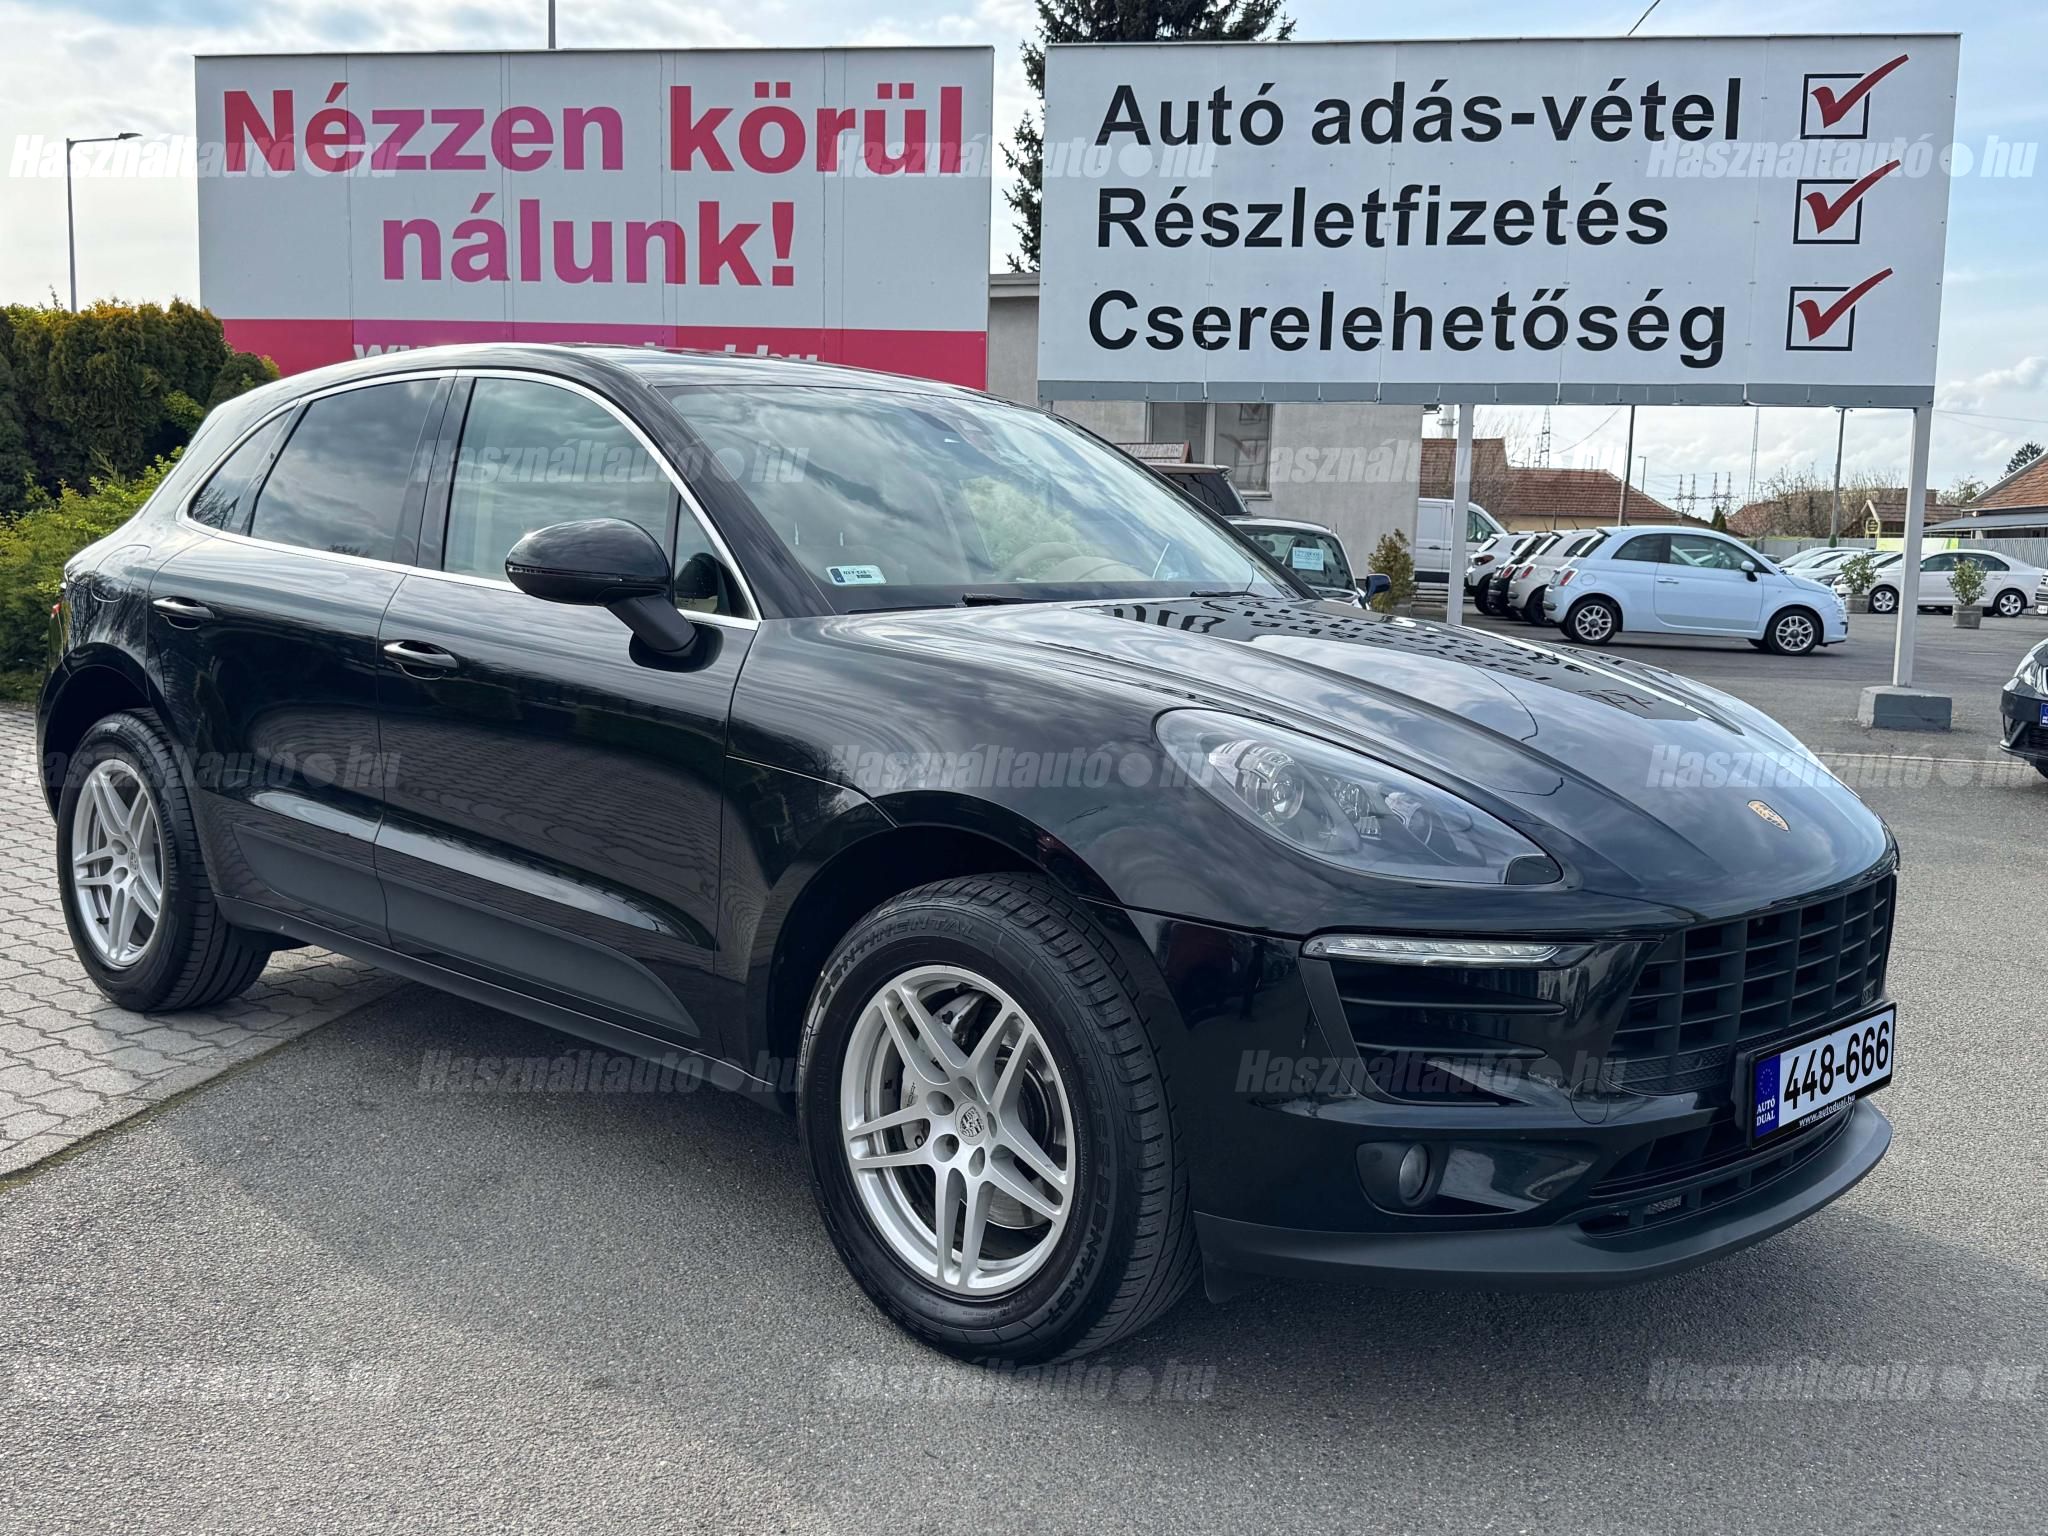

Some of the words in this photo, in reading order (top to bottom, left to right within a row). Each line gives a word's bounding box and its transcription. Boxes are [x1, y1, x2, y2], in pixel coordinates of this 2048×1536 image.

[224, 82, 625, 174] Nézzen
[669, 80, 964, 176] körül
[1095, 82, 1284, 147] Autó
[1311, 77, 1742, 146] adás-vétel
[382, 192, 795, 288] nálunk!
[1098, 182, 1669, 249] Részletfizetés
[1088, 288, 1726, 369] Cserelehetőség
[1783, 1020, 1890, 1110] 448-666
[1756, 1095, 1776, 1115] AUTÓ
[1756, 1111, 1776, 1128] DUAL
[1798, 1094, 1856, 1128] www.autodual.hu
